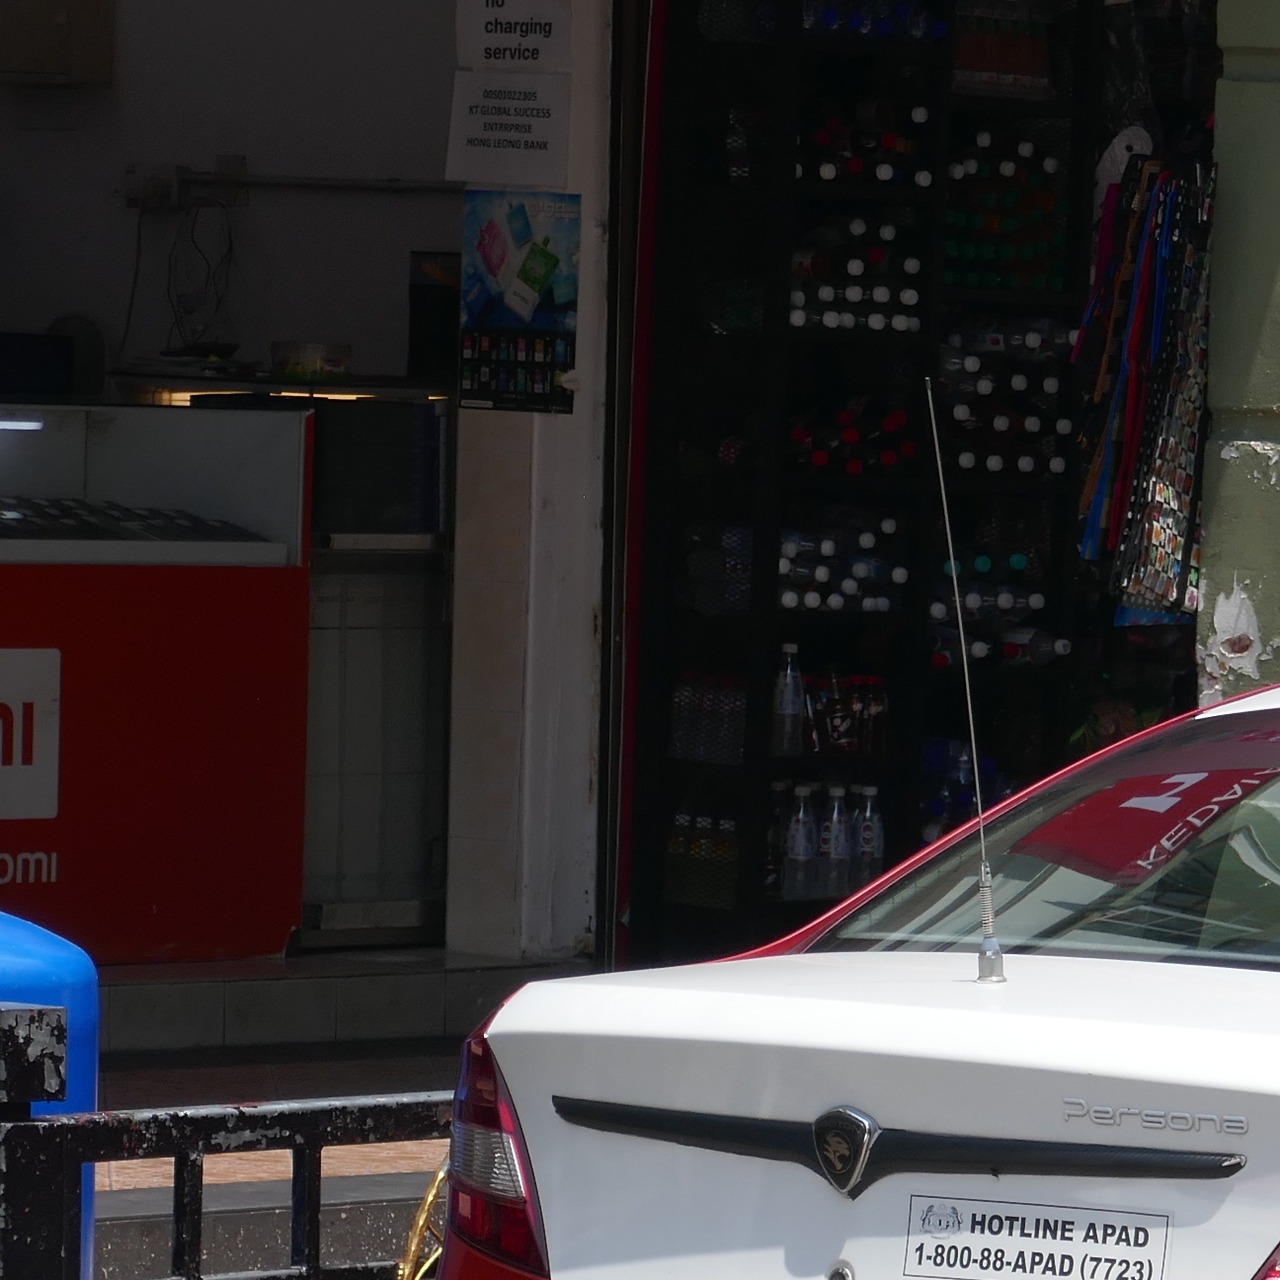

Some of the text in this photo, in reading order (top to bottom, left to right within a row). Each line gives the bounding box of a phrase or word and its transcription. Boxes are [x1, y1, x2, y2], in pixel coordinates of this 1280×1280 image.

[485, 18, 553, 38] charging
[484, 43, 540, 61] service
[481, 105, 512, 117] GLOBAL
[513, 107, 552, 119] SUCCESS
[466, 137, 549, 151] HONG LEONG BANK
[1062, 1097, 1249, 1135] Persona
[970, 1213, 1150, 1248] HOTLINE APAD
[914, 1242, 1075, 1278] 1-800-88-APAD
